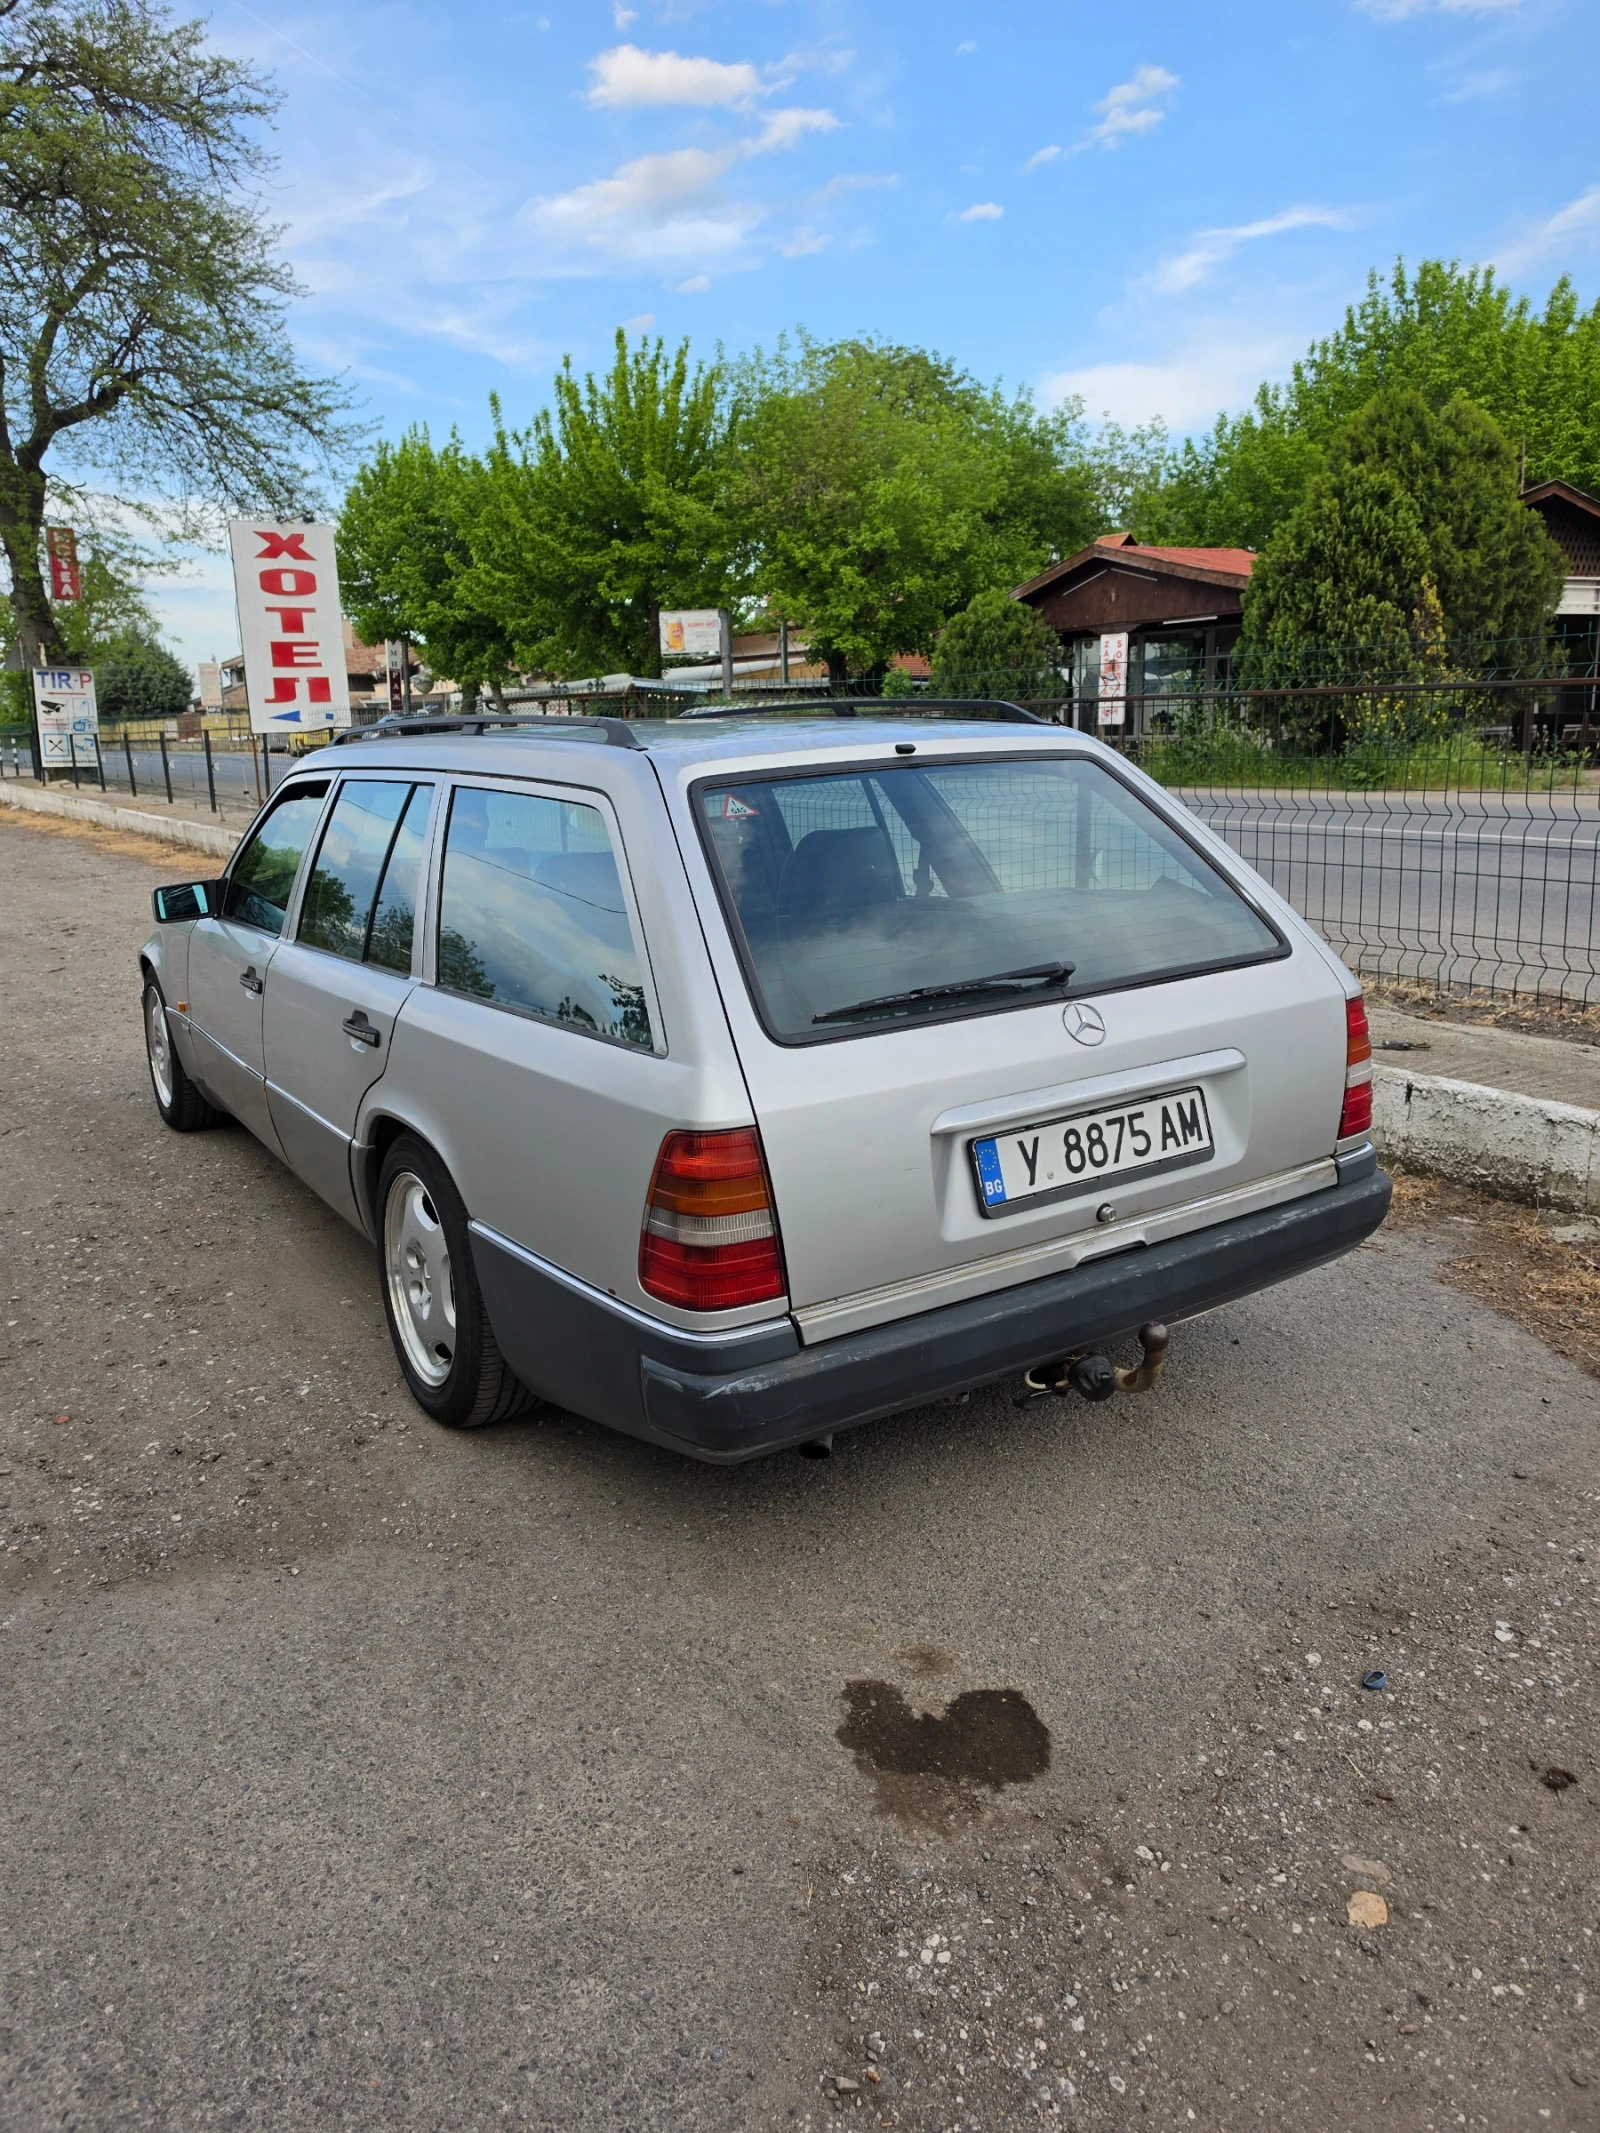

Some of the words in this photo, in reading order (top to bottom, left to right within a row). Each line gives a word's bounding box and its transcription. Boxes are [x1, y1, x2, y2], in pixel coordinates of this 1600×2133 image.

[252, 531, 332, 704] ХОТЕЛ
[730, 806, 747, 815] GAS
[1063, 1111, 1152, 1174] 8875
[1161, 1098, 1203, 1151] AM
[984, 1179, 1003, 1196] BG
